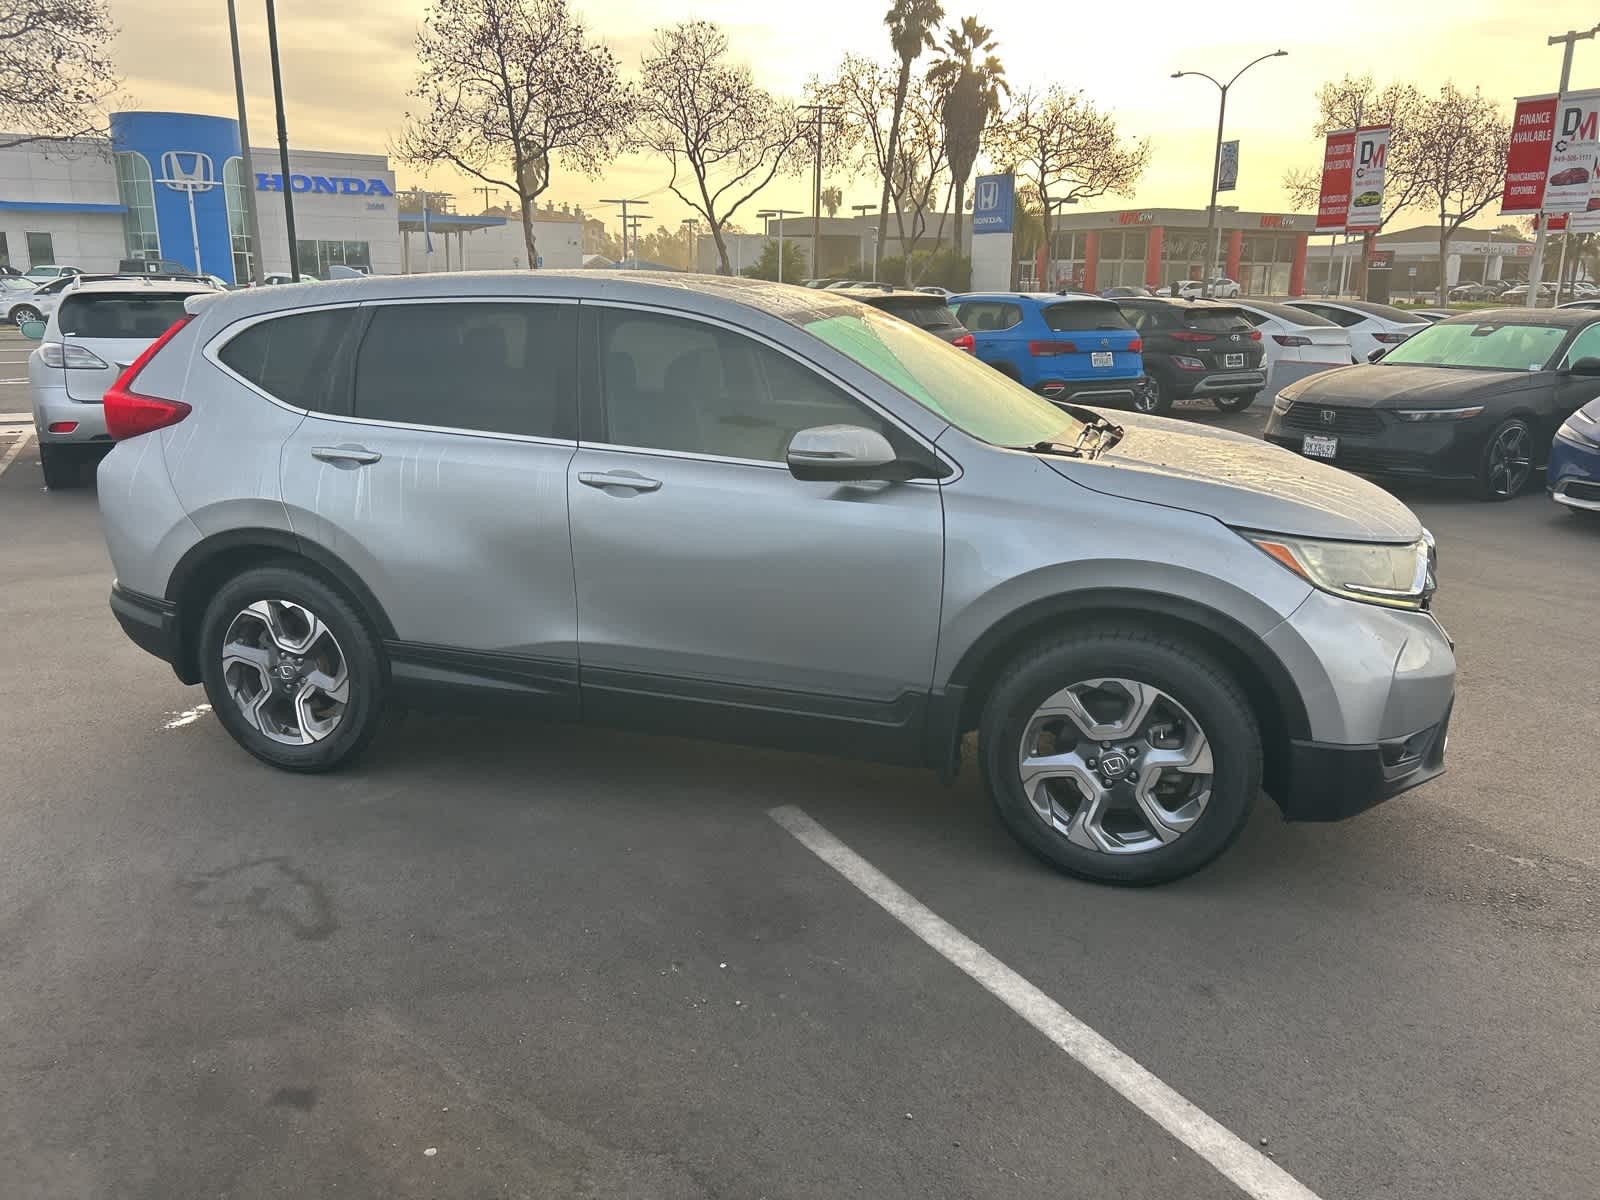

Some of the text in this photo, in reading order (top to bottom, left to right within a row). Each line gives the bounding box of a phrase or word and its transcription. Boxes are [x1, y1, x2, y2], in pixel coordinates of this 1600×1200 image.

[1519, 111, 1551, 126] FINANCE
[1513, 129, 1552, 143] AVAILABLE
[255, 173, 393, 197] HONDA
